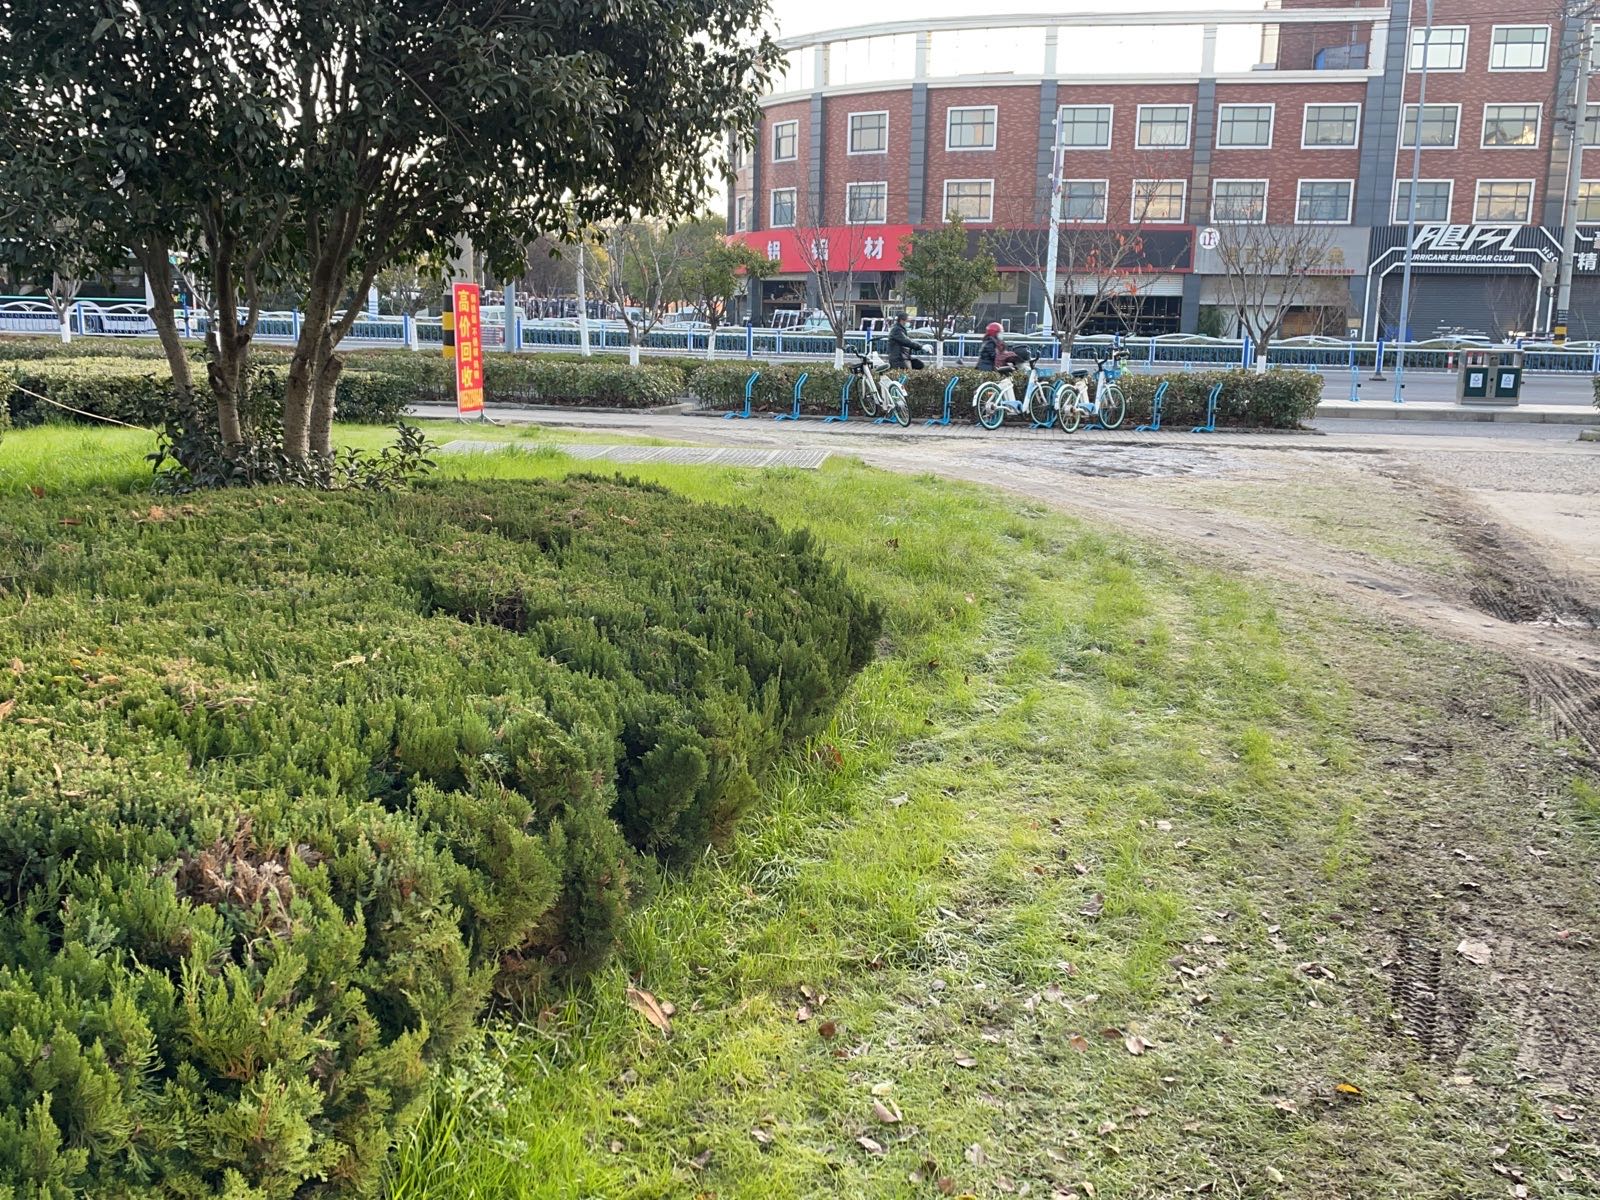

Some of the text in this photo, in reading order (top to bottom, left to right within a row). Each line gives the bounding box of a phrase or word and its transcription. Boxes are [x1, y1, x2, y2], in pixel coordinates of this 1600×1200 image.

[1493, 254, 1515, 262] CLUB
[458, 289, 473, 388] 高价回收
